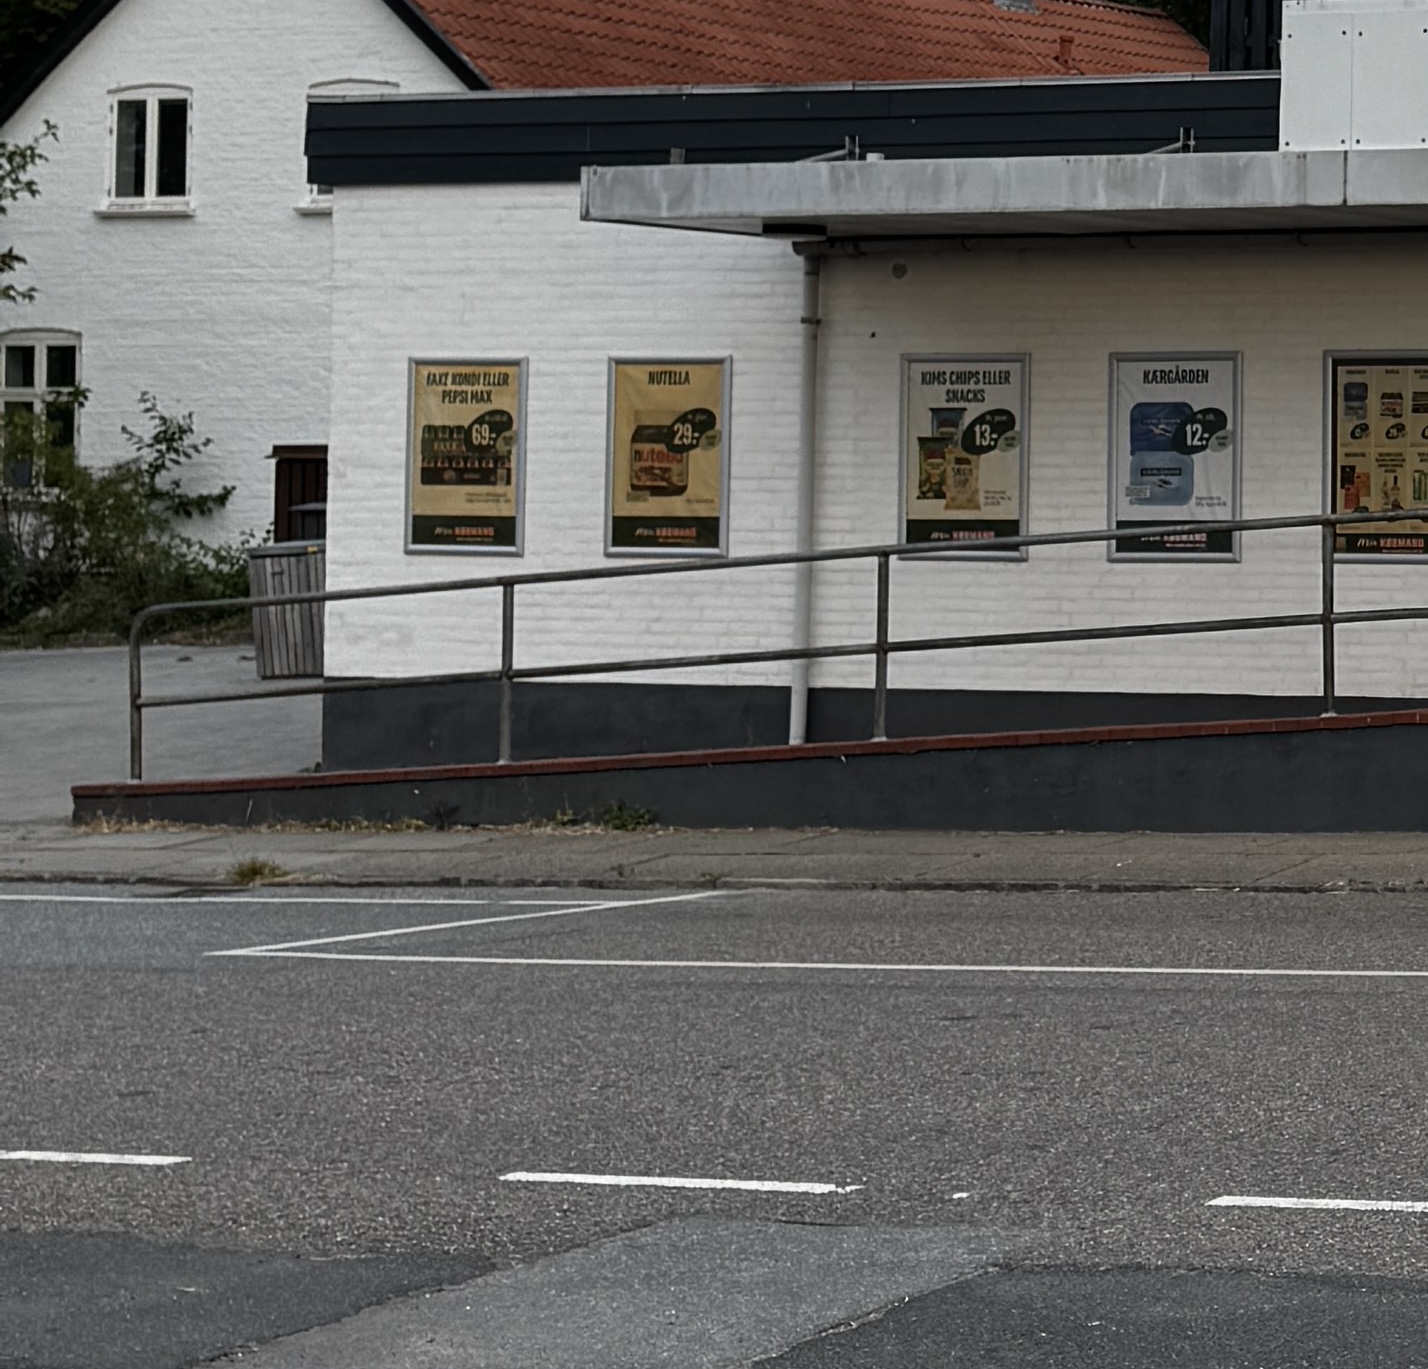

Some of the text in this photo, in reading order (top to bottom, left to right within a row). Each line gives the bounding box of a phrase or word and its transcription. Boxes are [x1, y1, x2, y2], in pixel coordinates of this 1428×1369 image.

[426, 371, 449, 387] FAXE
[483, 371, 509, 387] ELLER
[647, 370, 690, 386] NUTELLA
[949, 370, 981, 386] CHIPS
[982, 370, 1011, 386] ELLER
[1142, 365, 1210, 385] KÆRGÅRDEN
[441, 389, 493, 405] PEPSI MAX
[945, 388, 986, 404] SNACKS
